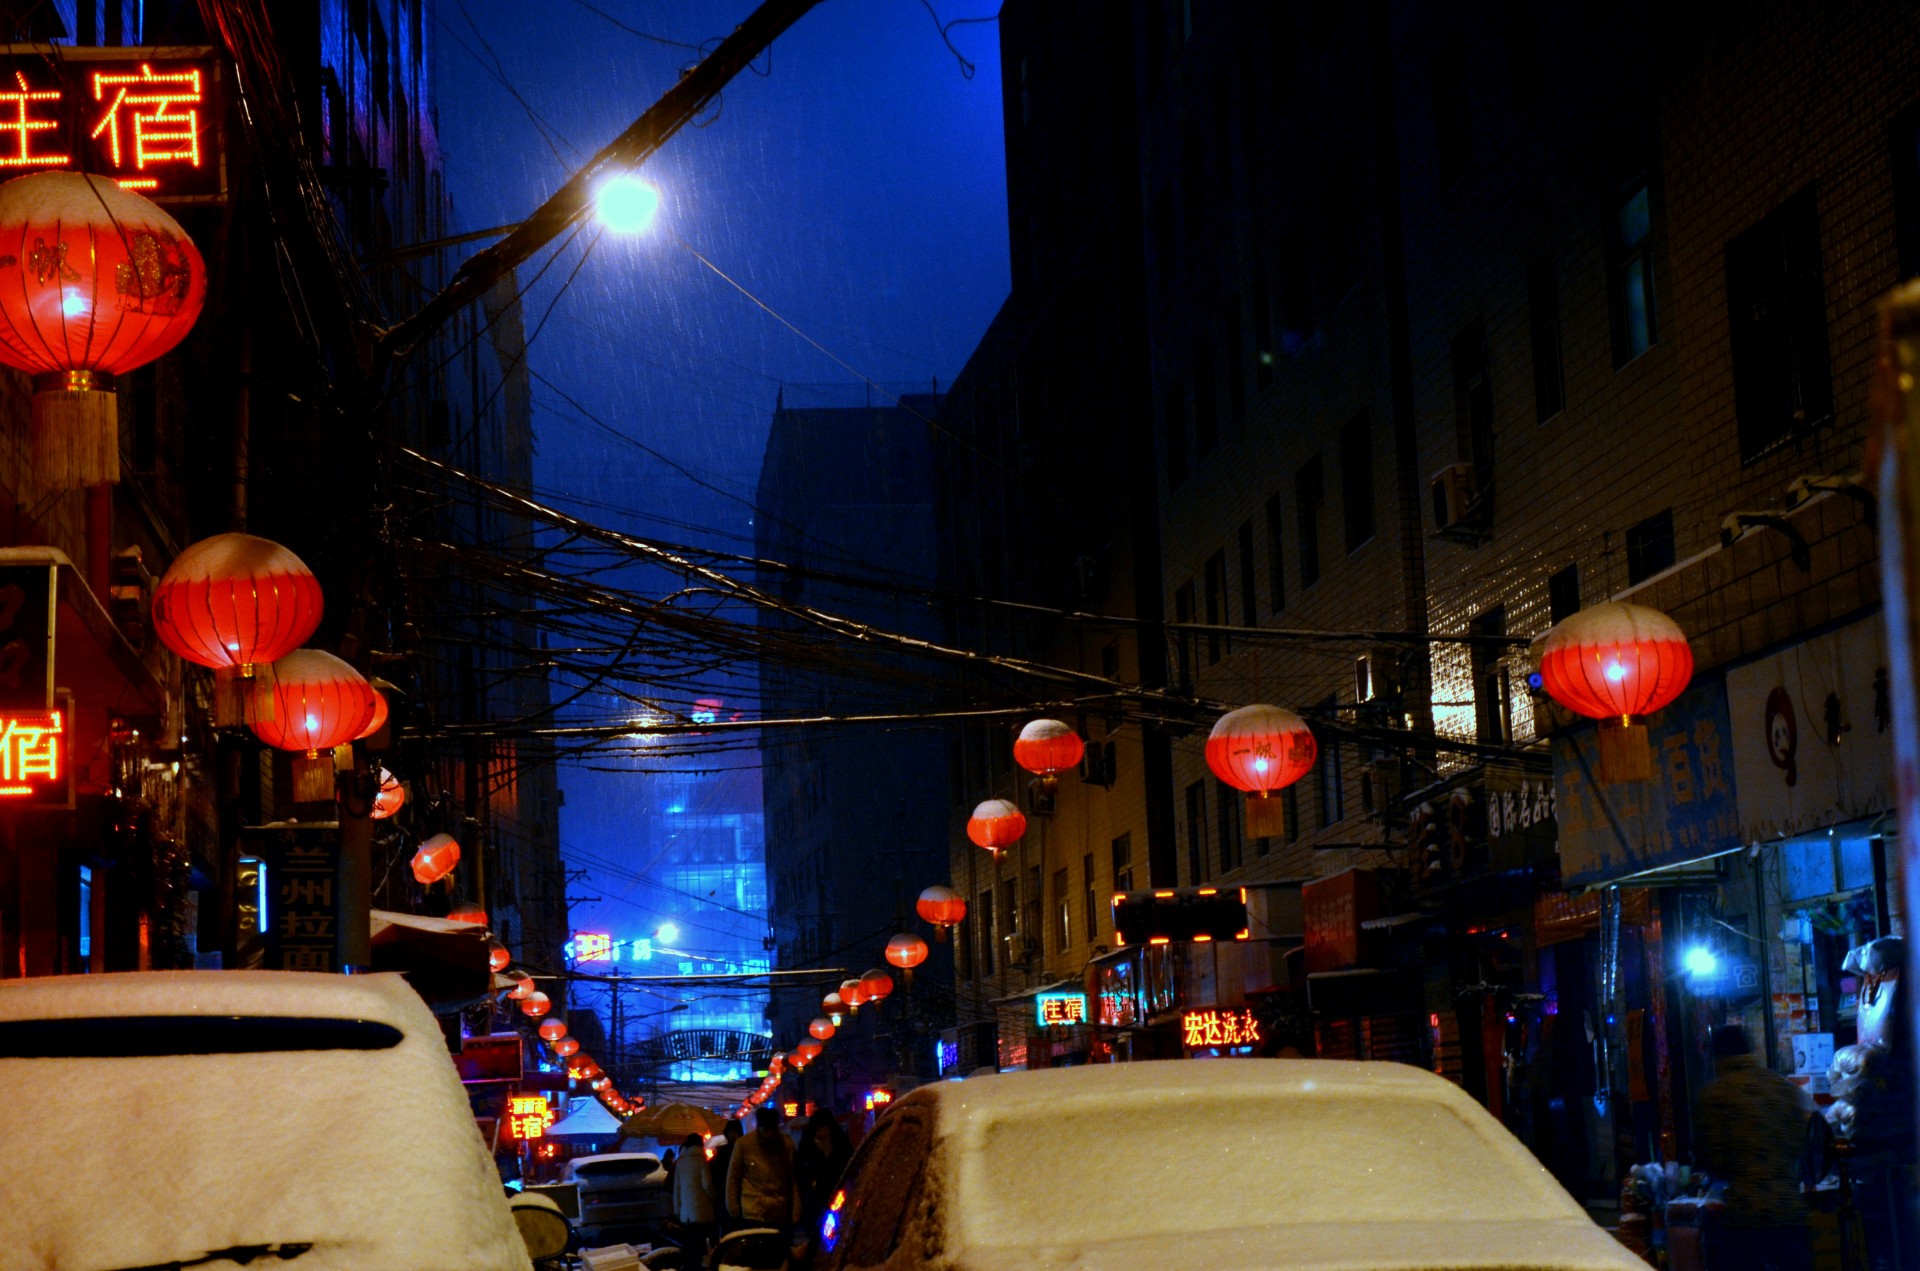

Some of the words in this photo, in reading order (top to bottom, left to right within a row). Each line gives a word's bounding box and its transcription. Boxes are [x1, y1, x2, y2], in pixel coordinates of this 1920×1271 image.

[279, 845, 336, 971] 兰州拉面
[1042, 997, 1083, 1019] 住宿
[1184, 1009, 1261, 1046] 宏达洗衣
